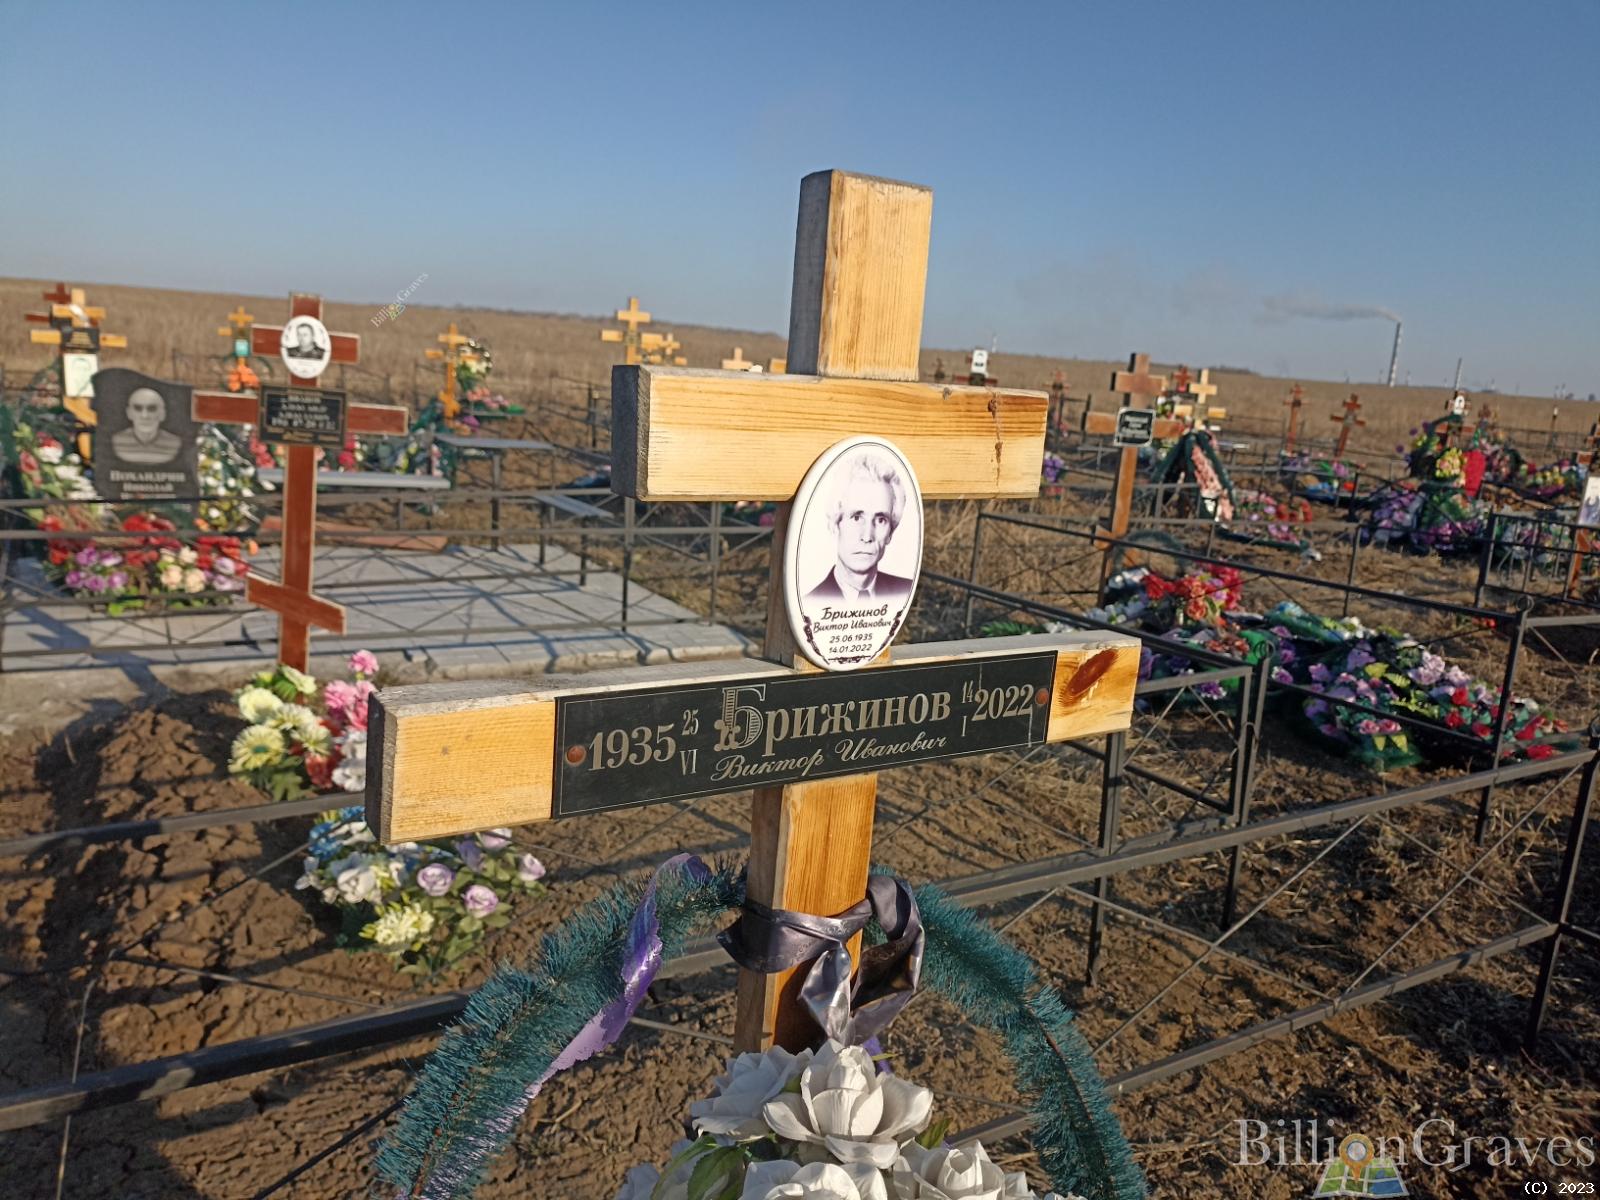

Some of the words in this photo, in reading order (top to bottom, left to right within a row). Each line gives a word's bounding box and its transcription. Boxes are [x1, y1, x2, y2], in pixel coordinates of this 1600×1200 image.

[813, 622, 848, 633] Виктор
[851, 618, 891, 629] Иванович
[821, 604, 888, 621] Брижинов
[829, 644, 872, 653] 14.01.2022
[961, 680, 974, 703] 14
[971, 684, 1034, 721] 2022
[681, 708, 699, 735] 25
[714, 684, 950, 757] Брижинов
[588, 723, 677, 771] 1935
[710, 749, 824, 781] Виктор
[835, 731, 947, 762] Иванович
[679, 748, 699, 776] VI
